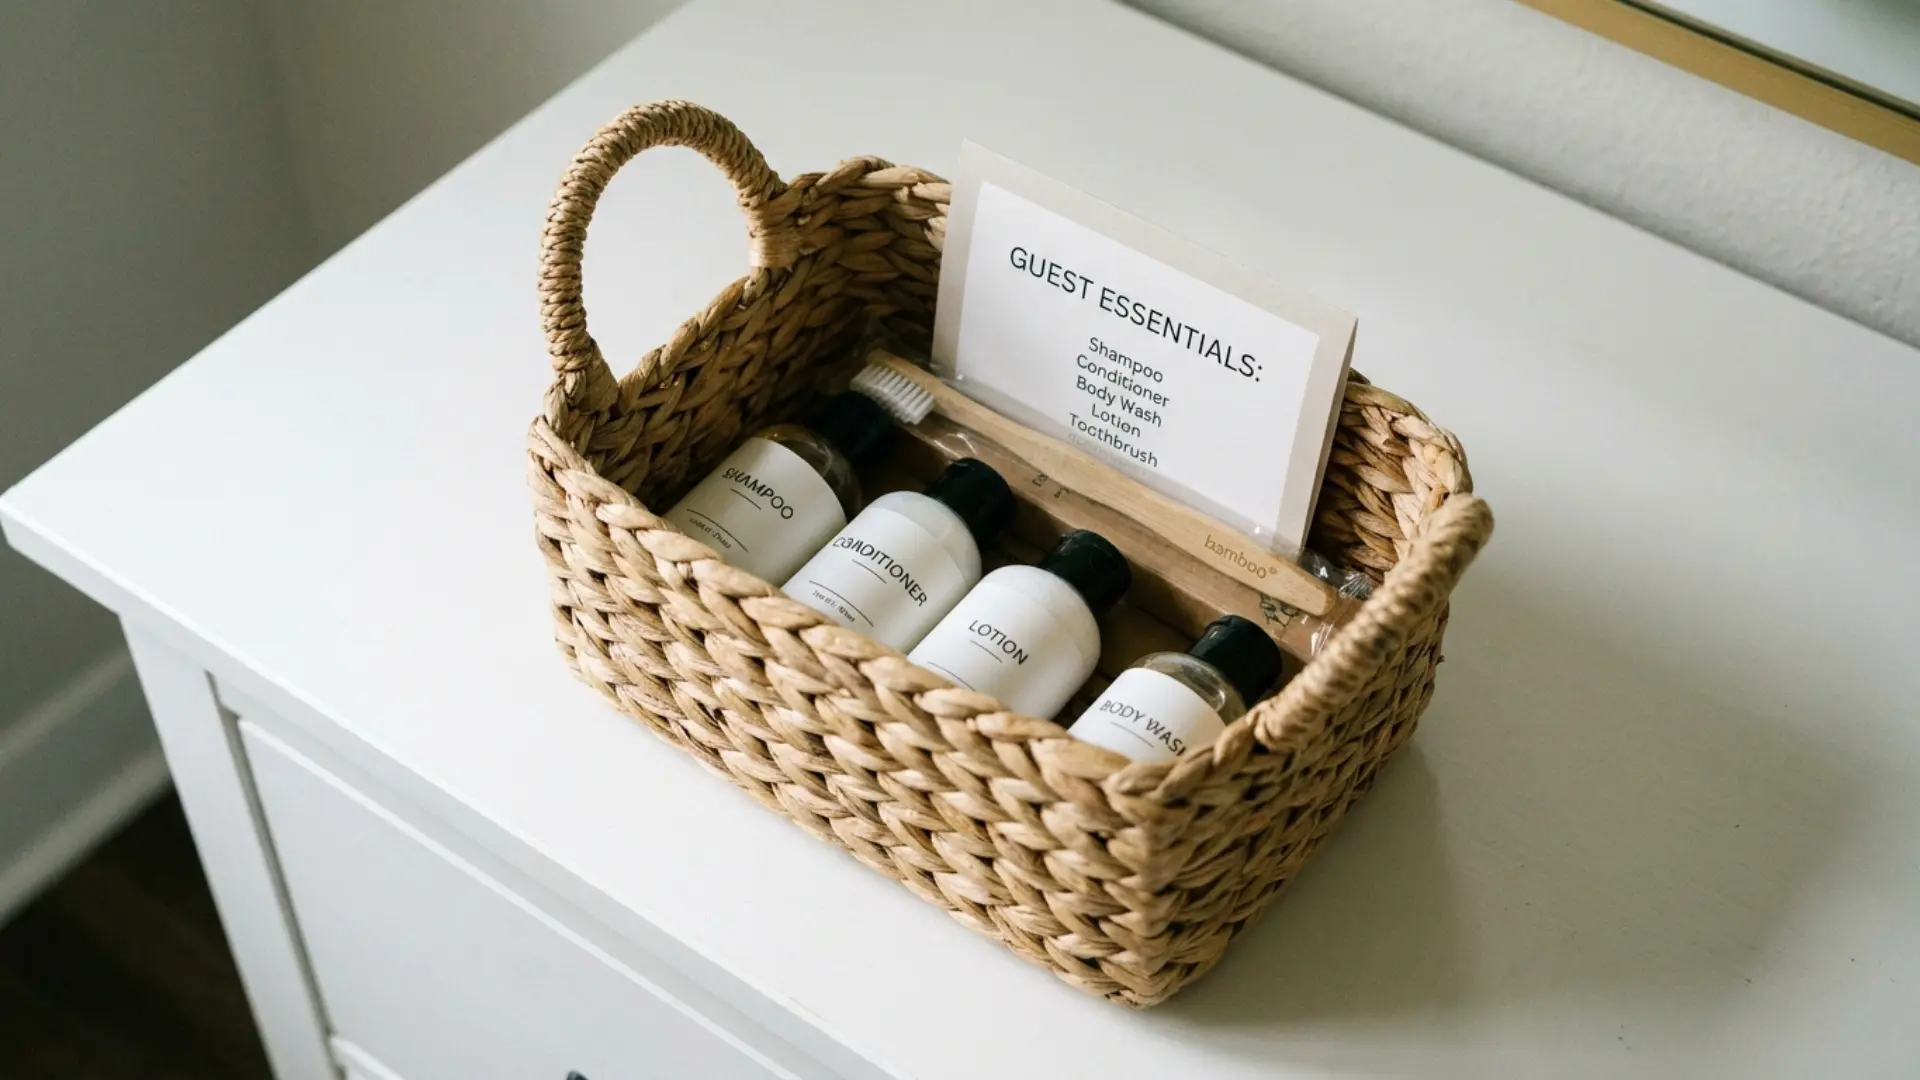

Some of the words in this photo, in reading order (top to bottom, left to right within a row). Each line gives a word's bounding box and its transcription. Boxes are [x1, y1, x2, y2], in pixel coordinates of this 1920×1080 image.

[1009, 246, 1094, 300] GUEST
[1099, 287, 1263, 382] ESSENTIALS:
[1076, 354, 1170, 407] Conditioner
[1088, 337, 1163, 383] Shampoo
[1076, 375, 1116, 406] Body
[1120, 396, 1162, 427] Wash
[1091, 404, 1141, 437] Lotion
[968, 619, 1029, 665] LOTION
